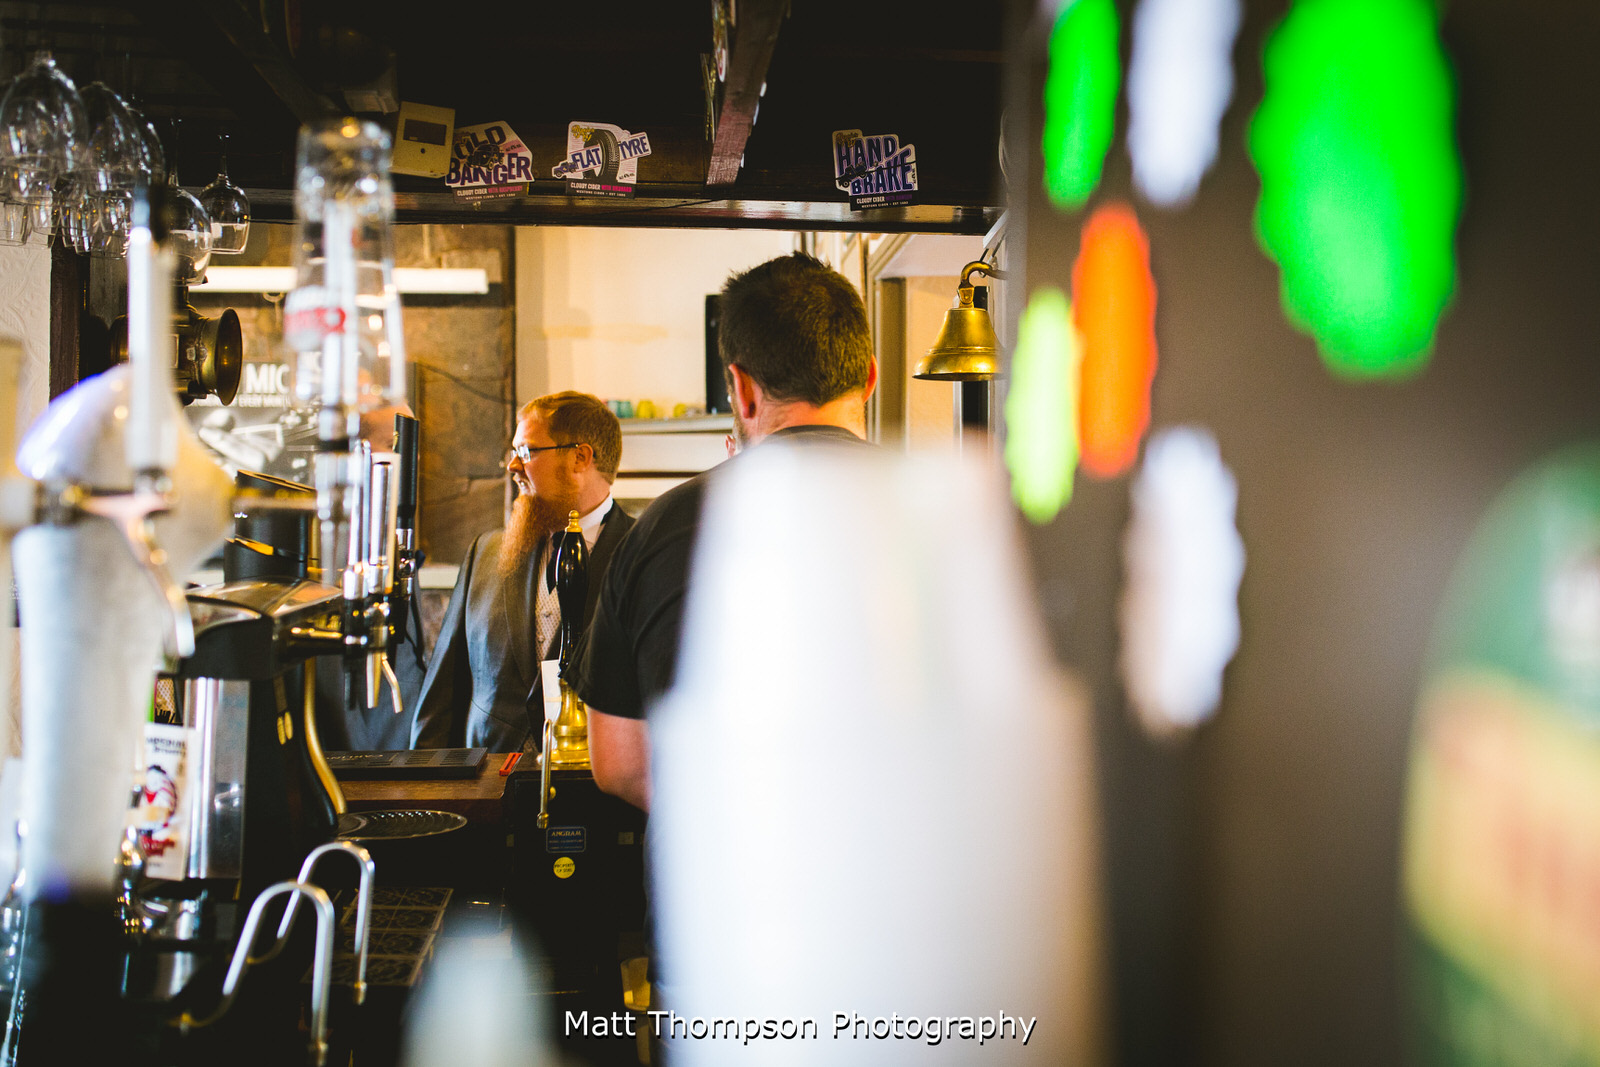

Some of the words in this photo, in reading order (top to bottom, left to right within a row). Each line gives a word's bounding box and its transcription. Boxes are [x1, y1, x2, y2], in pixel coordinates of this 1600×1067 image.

[571, 147, 602, 169] FLAT
[618, 136, 649, 160] TYRE
[836, 136, 898, 176] HAND
[446, 153, 533, 186] BANGER
[851, 148, 915, 195] BRAKE
[246, 363, 290, 394] MIC
